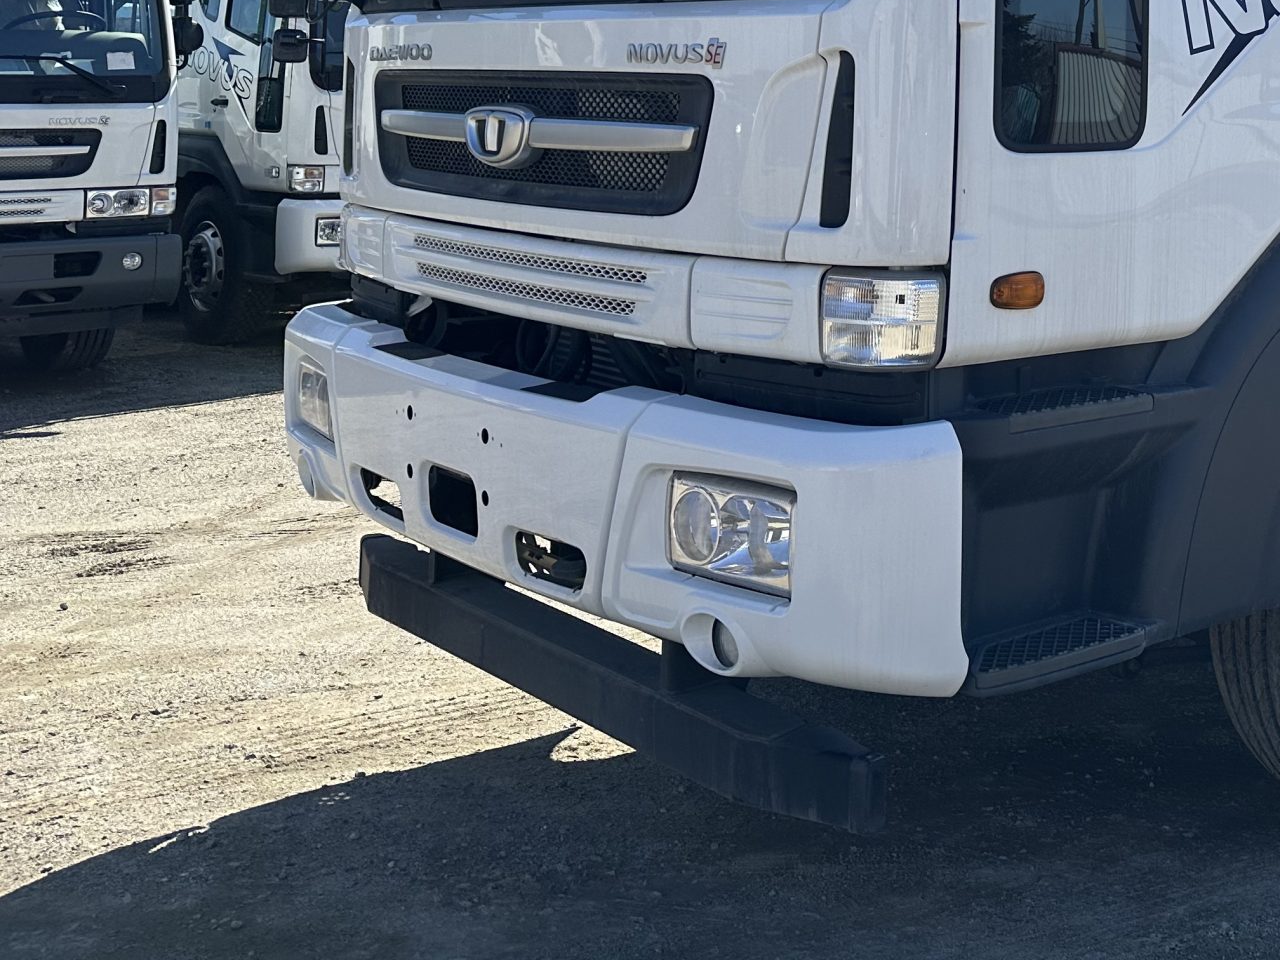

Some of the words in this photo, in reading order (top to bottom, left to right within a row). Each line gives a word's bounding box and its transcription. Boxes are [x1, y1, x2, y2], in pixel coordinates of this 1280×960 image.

[369, 43, 433, 62] DAEWOO
[627, 43, 704, 65] NOVUS
[48, 116, 98, 127] NOVUS
